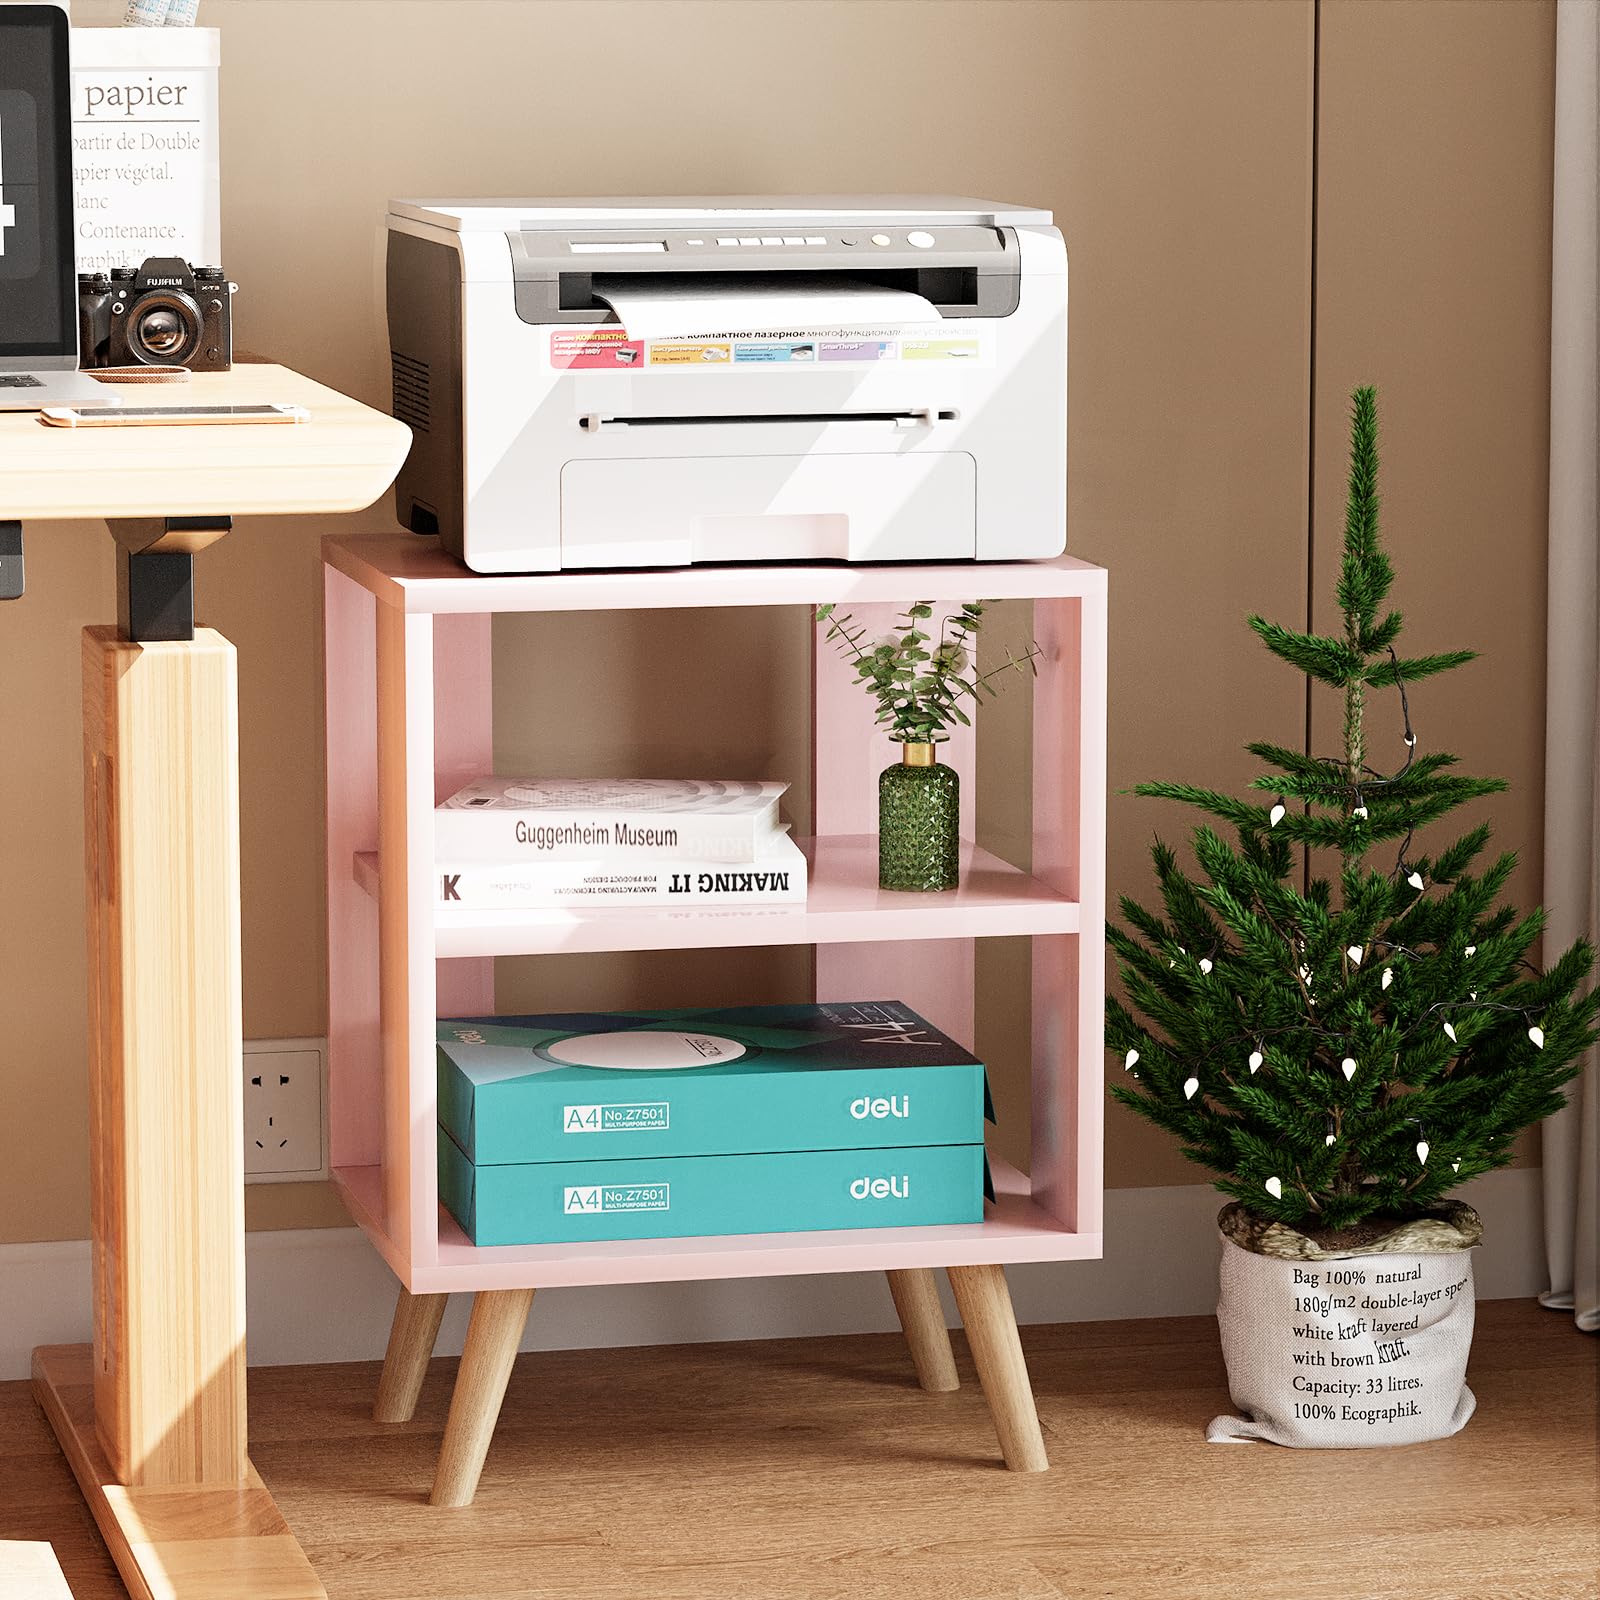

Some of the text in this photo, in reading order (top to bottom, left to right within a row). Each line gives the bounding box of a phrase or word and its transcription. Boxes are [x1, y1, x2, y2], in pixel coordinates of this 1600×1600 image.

[84, 76, 188, 117] papier
[117, 133, 136, 151] de
[141, 132, 200, 151] Double
[115, 162, 174, 187] végétal.
[79, 221, 176, 240] Contenance
[147, 278, 183, 287] FUJIFILM
[757, 330, 805, 340] лазерное
[515, 819, 678, 851] Guggenheim Museum
[668, 872, 789, 894] MAKING IT
[837, 1021, 943, 1046] A4
[567, 1108, 664, 1129] A4 No.Z7501
[849, 1095, 909, 1119] deli
[647, 1119, 666, 1127] PAPER
[567, 1189, 664, 1210] A4 No.Z7501
[849, 1176, 909, 1200] deli
[647, 1200, 666, 1208] PAPER
[1293, 1264, 1422, 1288] Bag 100% natural
[1294, 1294, 1356, 1318] 180g/m2
[1361, 1289, 1442, 1310] double-layer
[1292, 1315, 1419, 1341] white kraft layered
[1292, 1337, 1411, 1369] with brown kraft.
[1292, 1376, 1424, 1401] Capacity: 33 litres.
[1293, 1401, 1423, 1425] 100% Ecographik.
